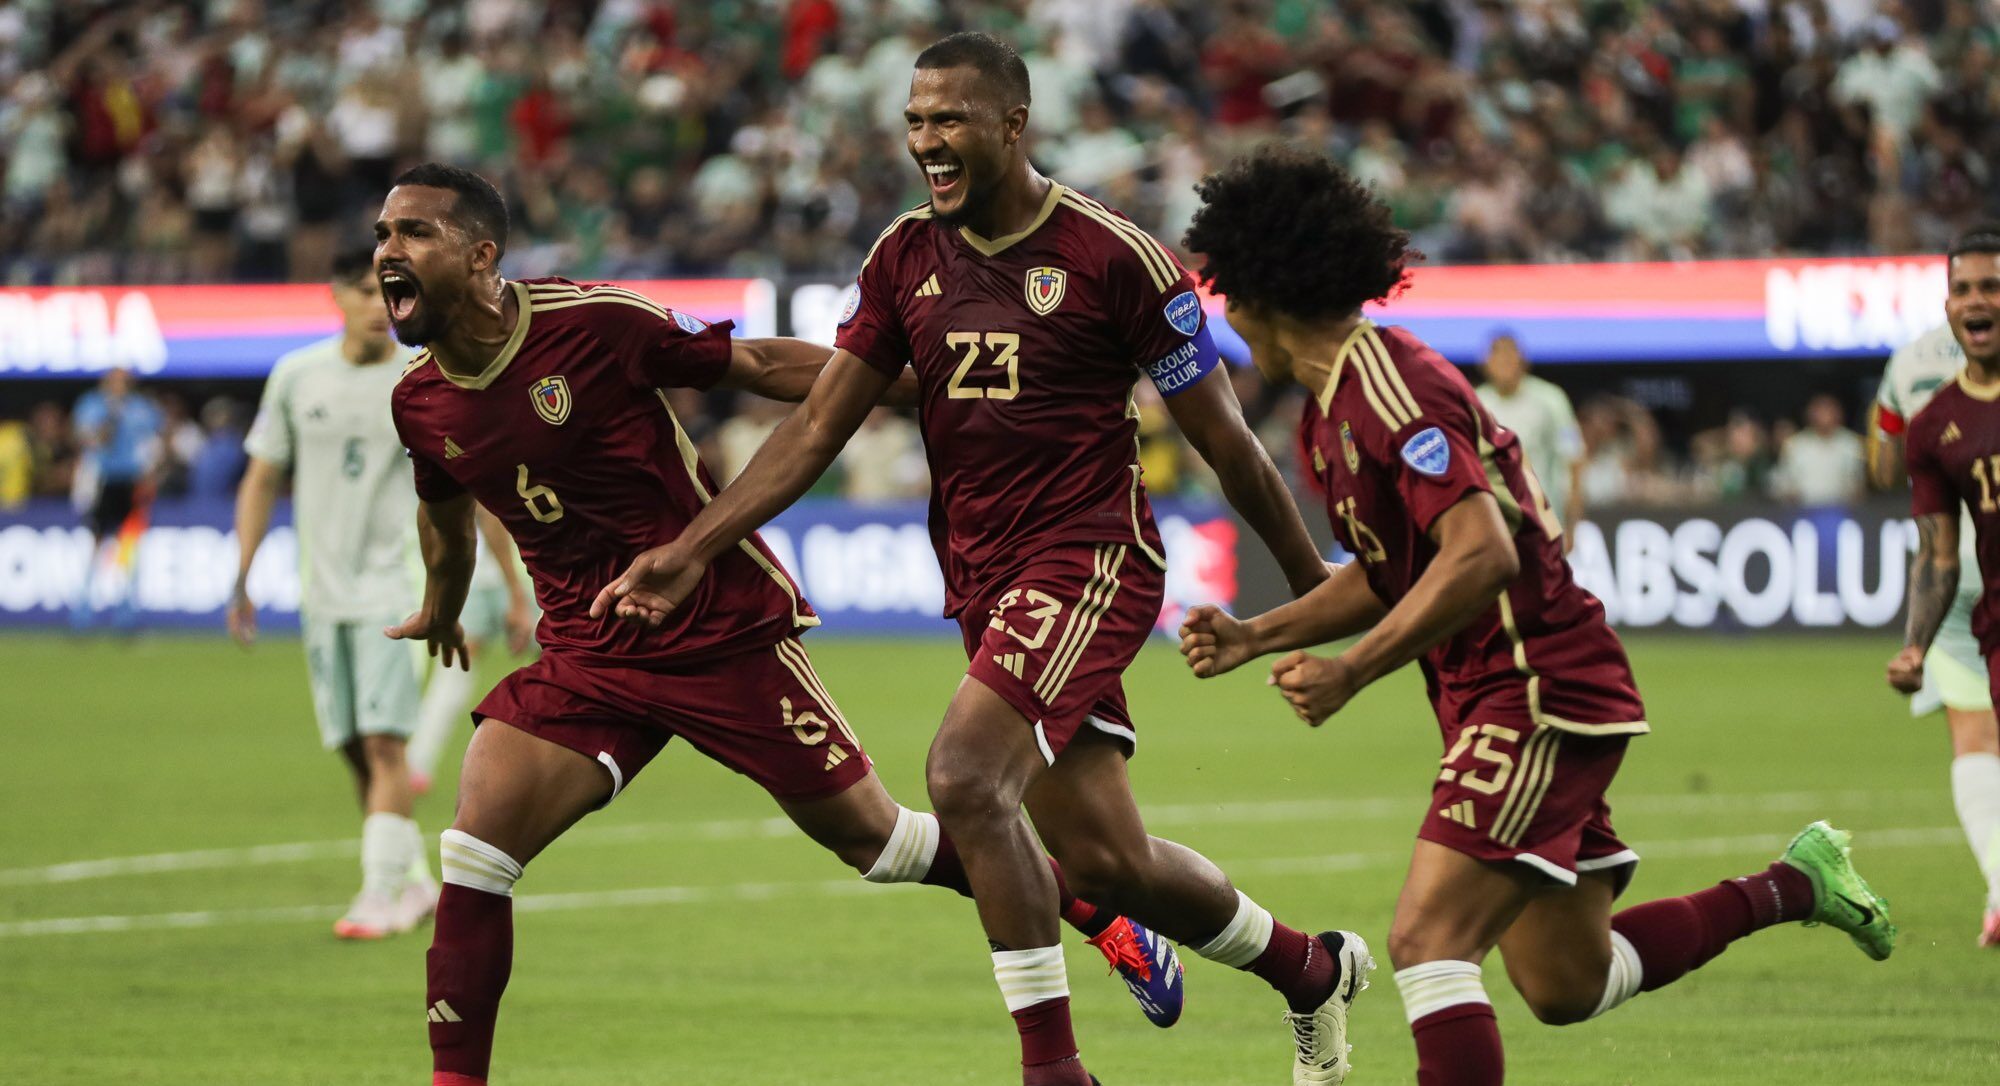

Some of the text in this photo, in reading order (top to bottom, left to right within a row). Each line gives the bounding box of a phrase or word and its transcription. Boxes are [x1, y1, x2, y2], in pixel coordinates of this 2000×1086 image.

[1171, 300, 1196, 320] VIBRA
[946, 331, 1020, 401] 23
[516, 463, 564, 524] 6
[989, 588, 1063, 650] 23
[779, 695, 829, 746] 6
